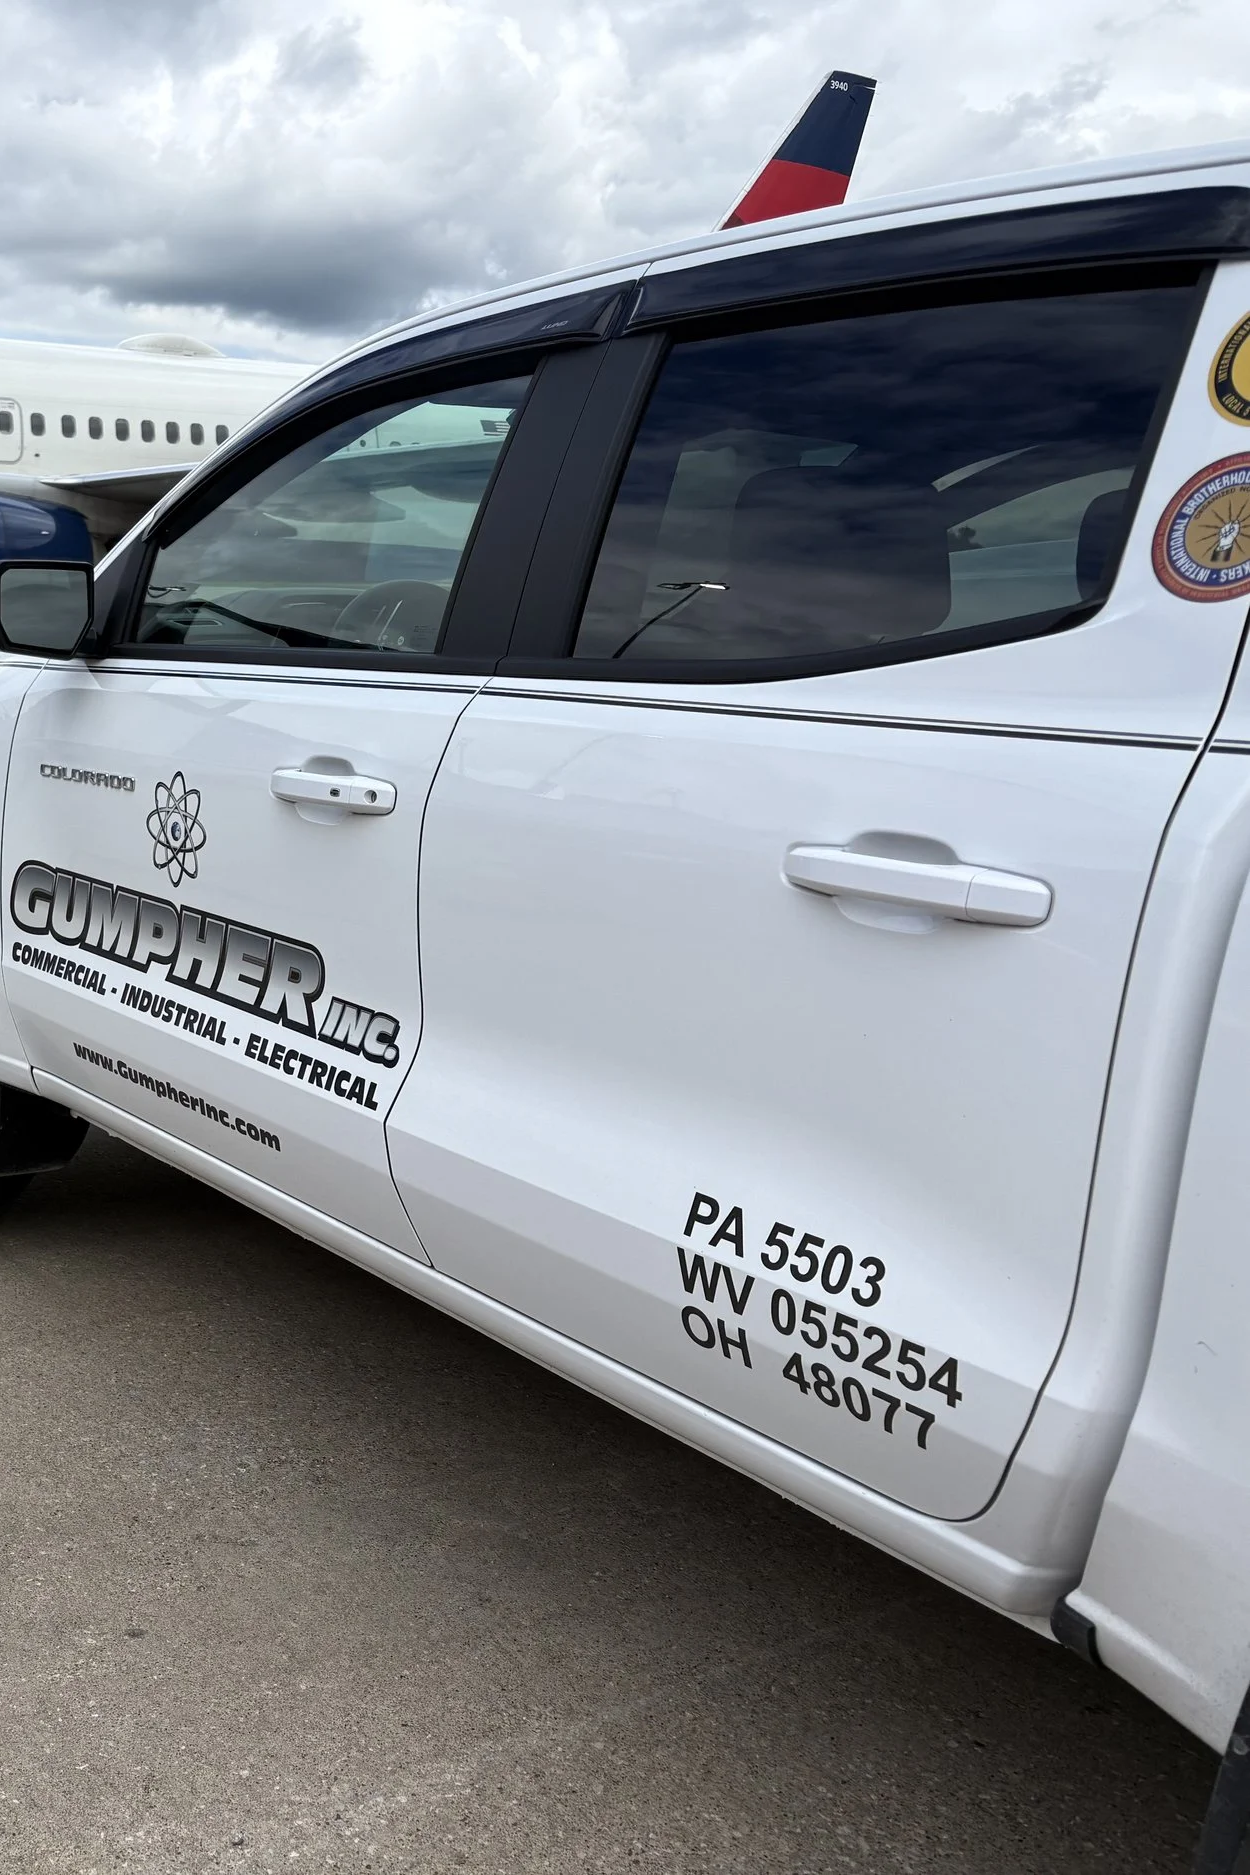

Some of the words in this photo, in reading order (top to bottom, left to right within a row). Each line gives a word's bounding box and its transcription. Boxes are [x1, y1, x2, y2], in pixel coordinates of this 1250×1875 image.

[830, 80, 848, 91] 3940
[1222, 393, 1244, 413] LOCAL
[1169, 517, 1211, 583] INTERNATIONAL
[1194, 488, 1236, 520] ORGANIZED
[40, 764, 135, 792] COLORADO
[10, 859, 325, 1039] GUMPHER
[318, 996, 400, 1068] INC.
[12, 942, 107, 996] COMMERCIAL
[120, 982, 226, 1046] INDUSTRIAL
[244, 1033, 378, 1111] ELECTRICAL
[73, 1042, 281, 1152] www.GumpherInc.com
[683, 1192, 745, 1258] PA
[760, 1221, 886, 1307] 5503
[676, 1246, 755, 1316] WV
[771, 1288, 963, 1409] 055254
[681, 1305, 753, 1369] OH
[782, 1352, 935, 1450] 48077
